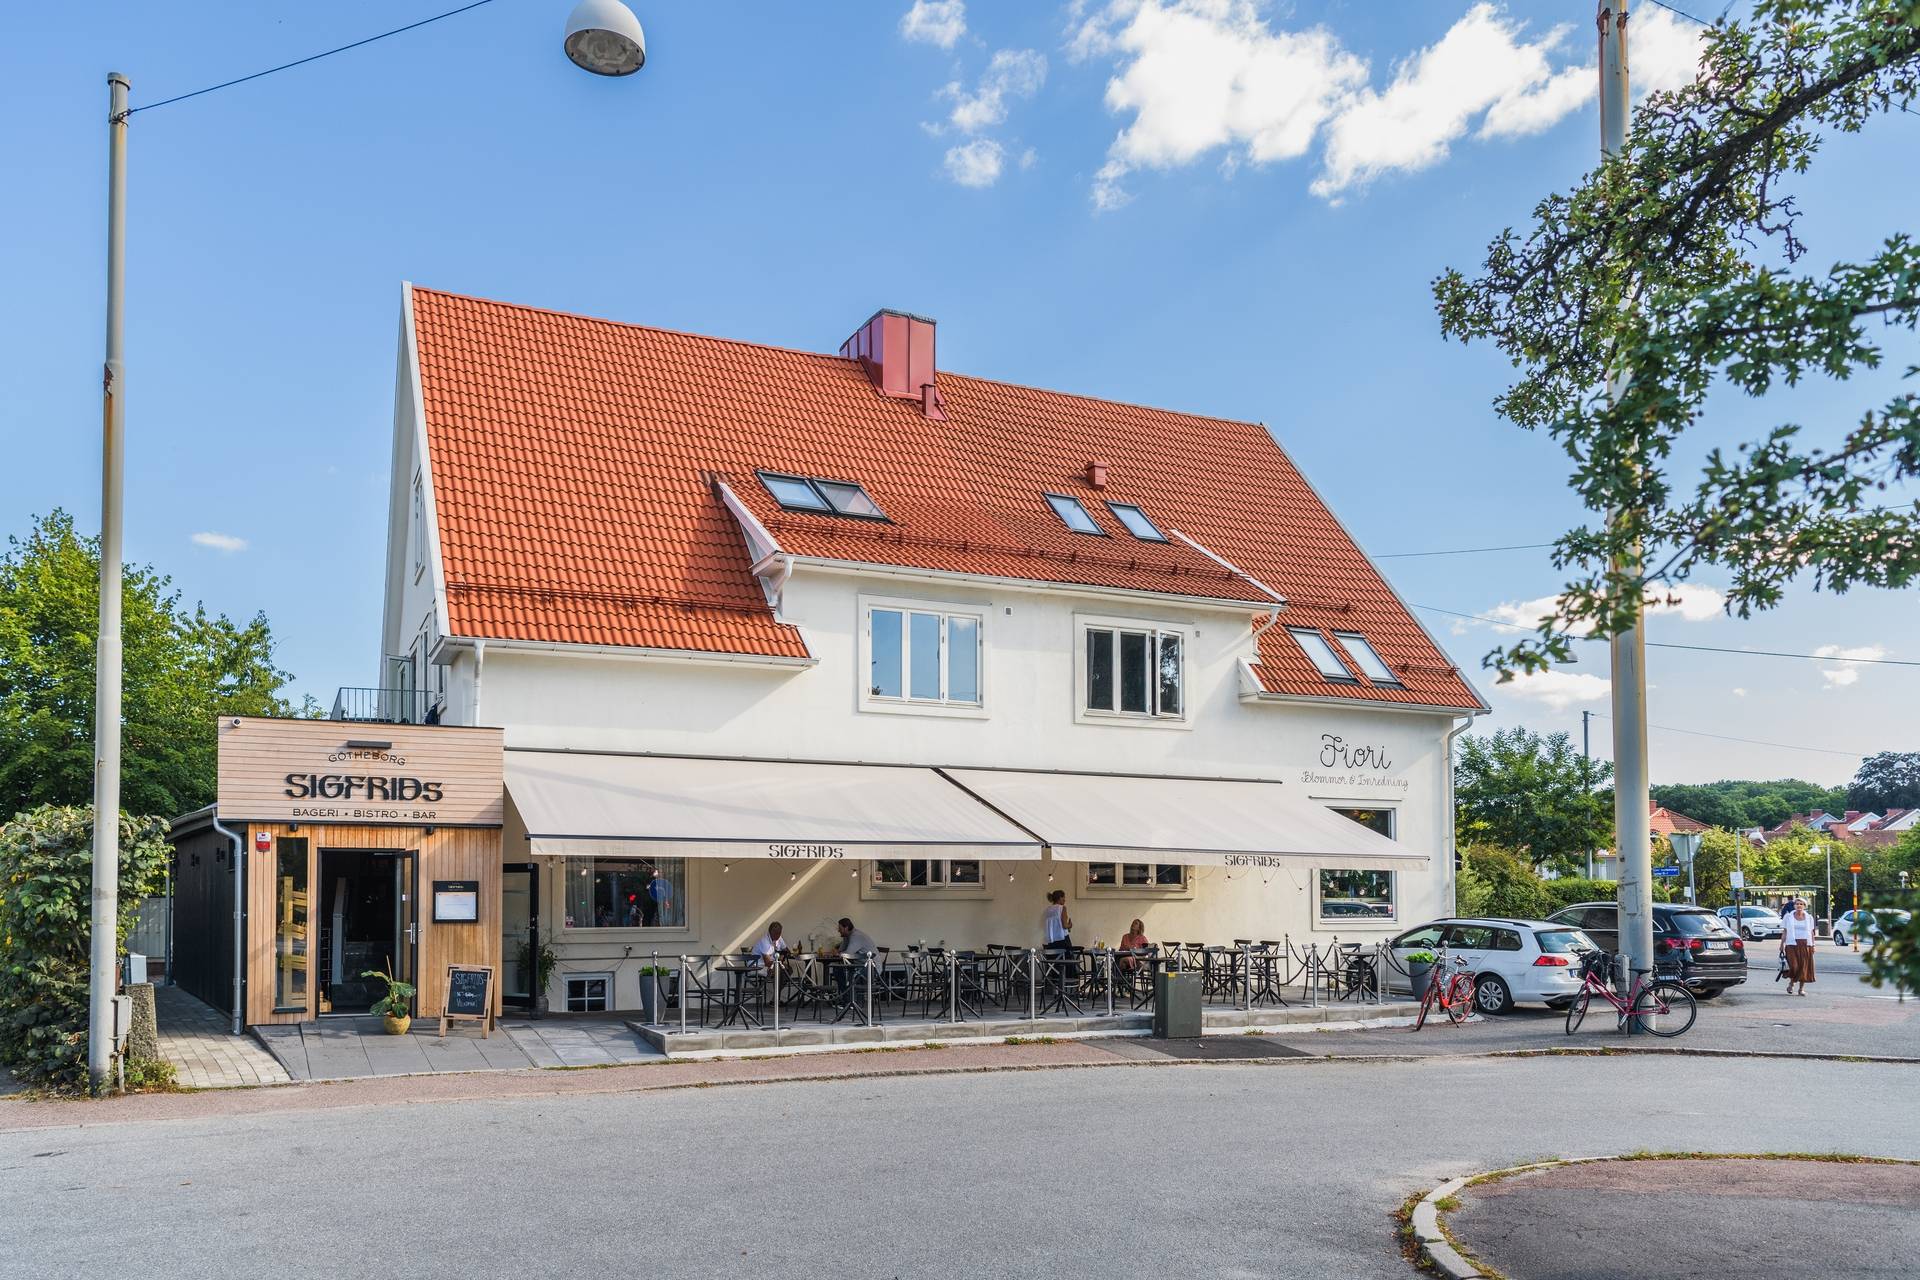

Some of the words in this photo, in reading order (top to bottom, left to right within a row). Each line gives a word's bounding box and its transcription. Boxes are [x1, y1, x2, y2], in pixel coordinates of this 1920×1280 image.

[1320, 734, 1392, 769] Fiori
[285, 774, 443, 801] SIGFRIDS
[1301, 771, 1347, 785] Blommor
[1357, 774, 1408, 791] Inredning
[293, 808, 339, 817] BAGERI
[353, 810, 398, 819] BISTRO
[412, 811, 436, 819] BAR
